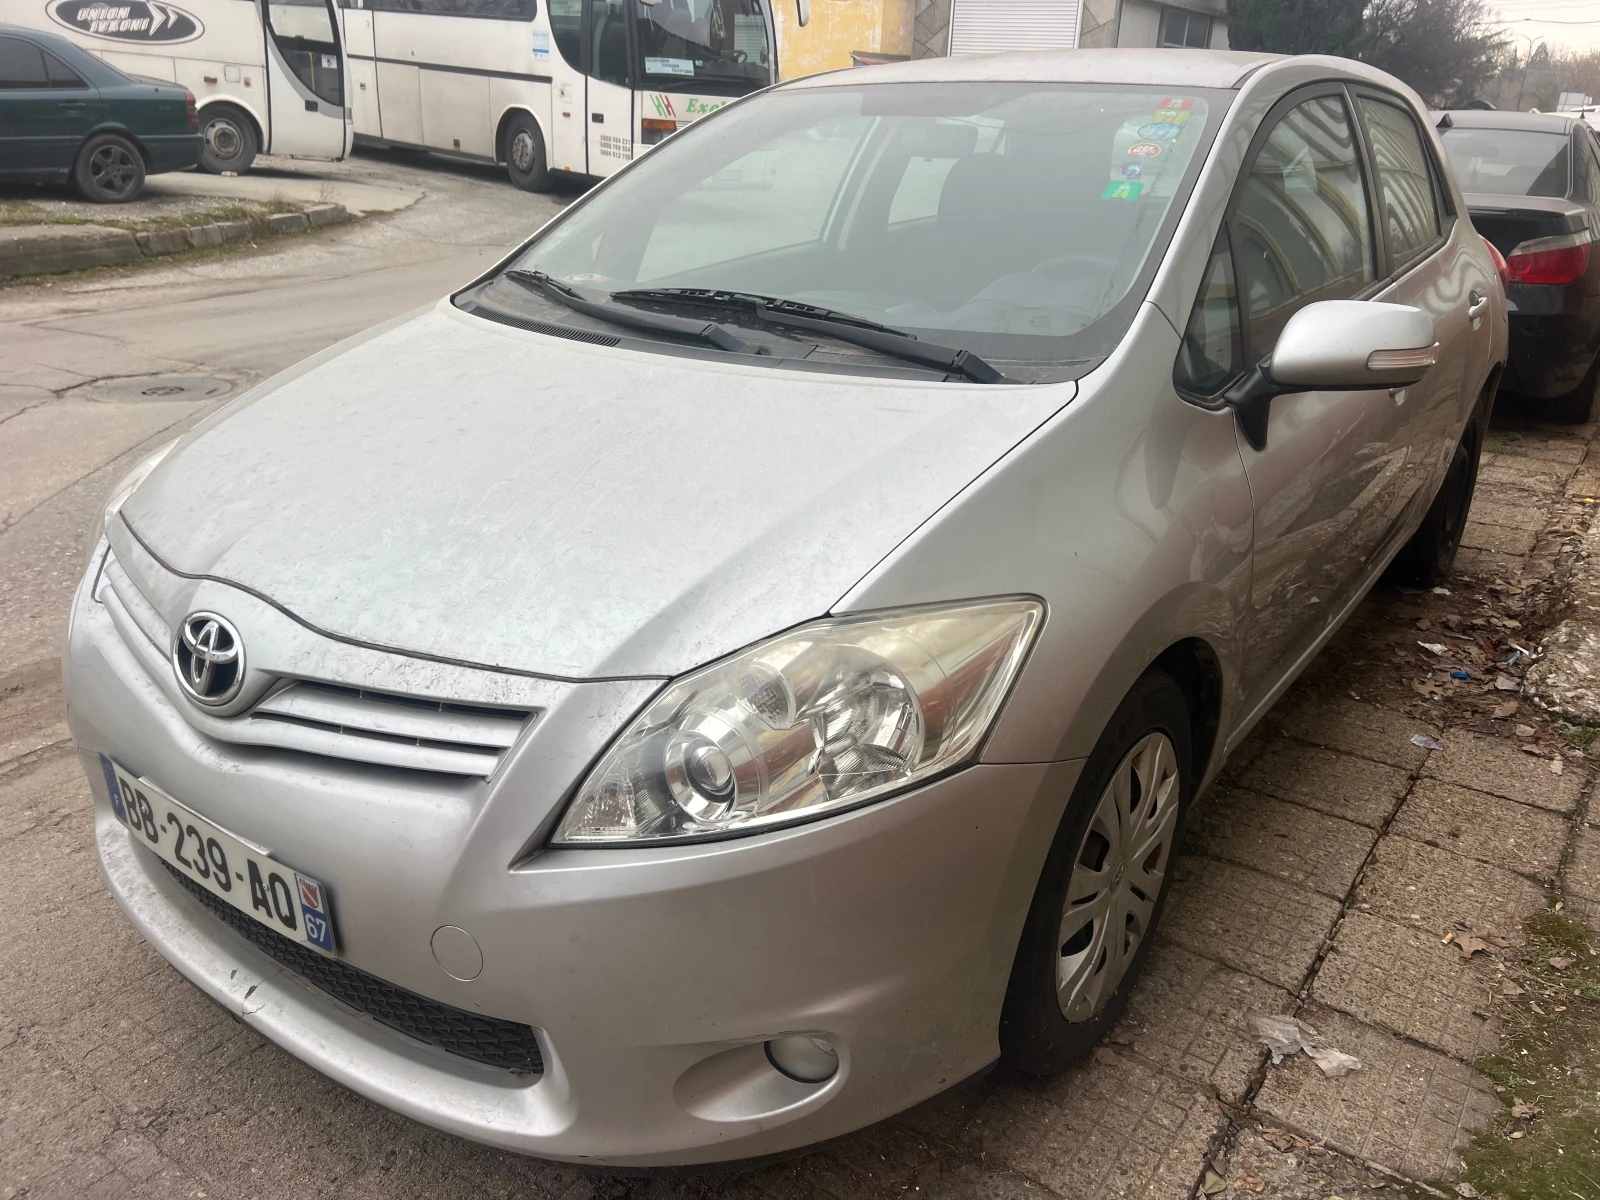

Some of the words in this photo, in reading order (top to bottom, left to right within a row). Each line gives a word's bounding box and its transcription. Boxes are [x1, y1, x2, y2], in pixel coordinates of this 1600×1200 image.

[77, 6, 131, 21] UNION
[89, 17, 150, 33] IVKONI
[118, 775, 298, 932] BB-239-AQ
[305, 913, 327, 943] 67
